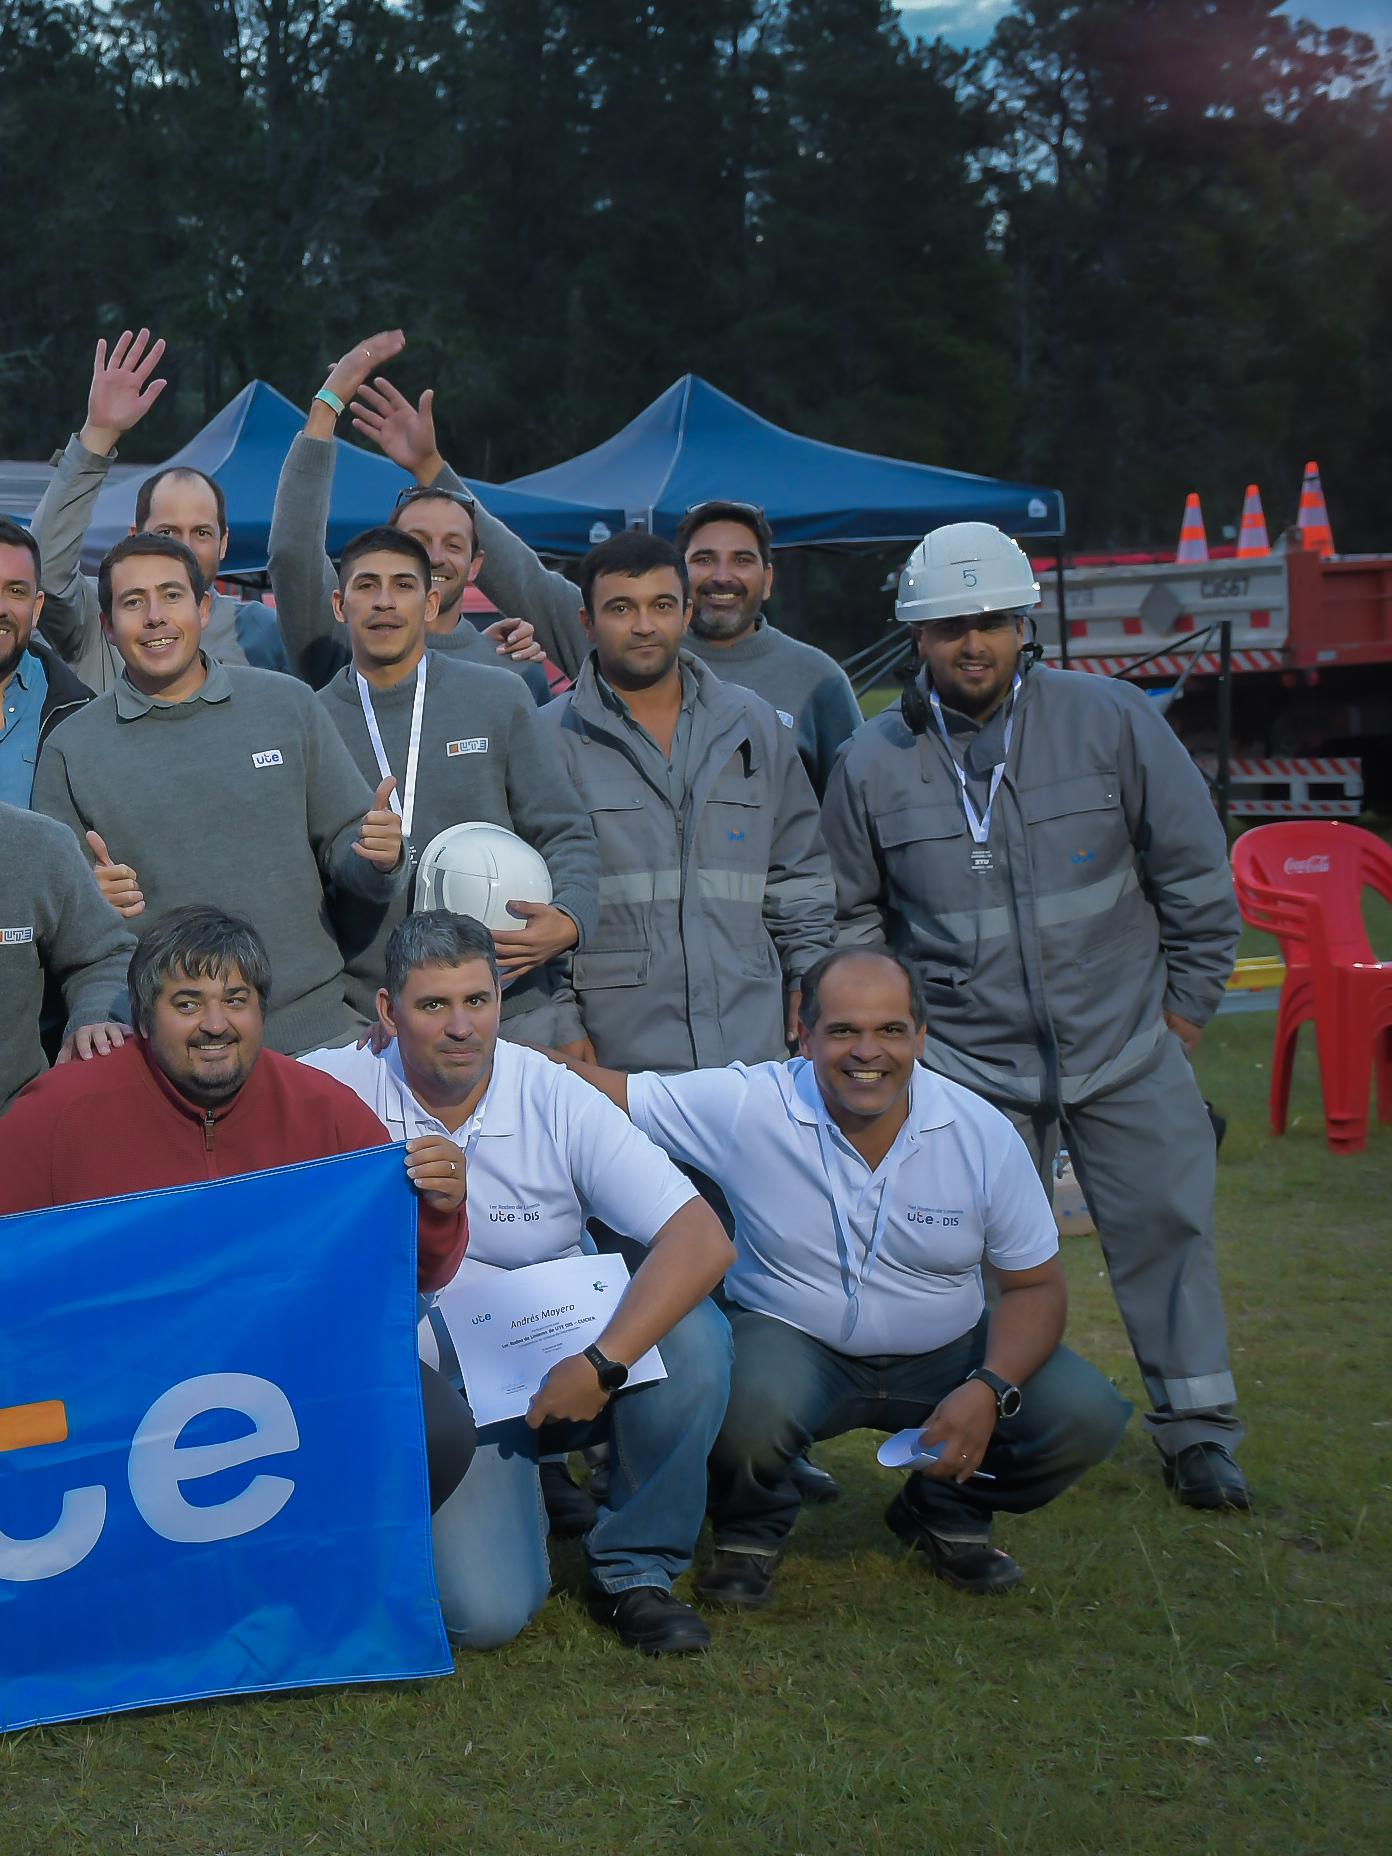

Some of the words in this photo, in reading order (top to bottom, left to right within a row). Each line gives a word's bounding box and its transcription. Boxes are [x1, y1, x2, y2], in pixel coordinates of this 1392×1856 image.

[962, 569, 976, 588] 5
[256, 752, 279, 765] ute
[489, 1210, 516, 1223] ute
[523, 1210, 541, 1222] DIS
[907, 1211, 934, 1225] ute
[942, 1216, 959, 1227] DIS
